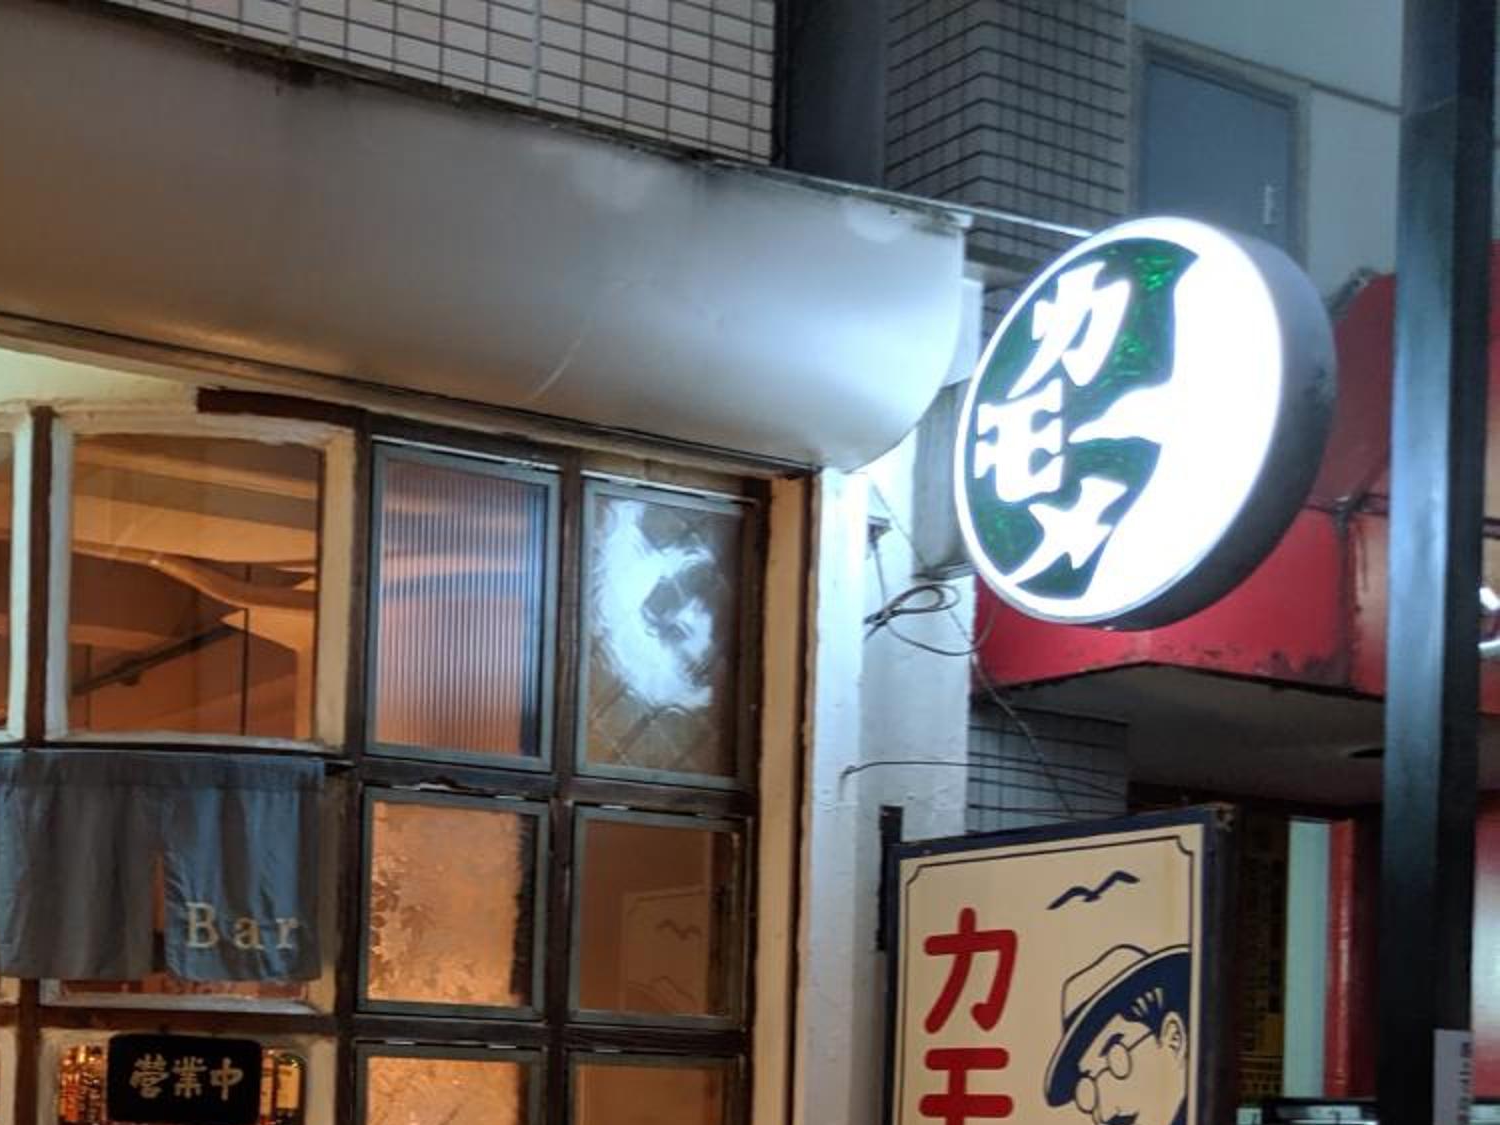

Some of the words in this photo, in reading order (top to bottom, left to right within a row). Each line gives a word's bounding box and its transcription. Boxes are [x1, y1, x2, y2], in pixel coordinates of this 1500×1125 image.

[974, 261, 1132, 585] カモメ
[186, 902, 299, 949] Bar
